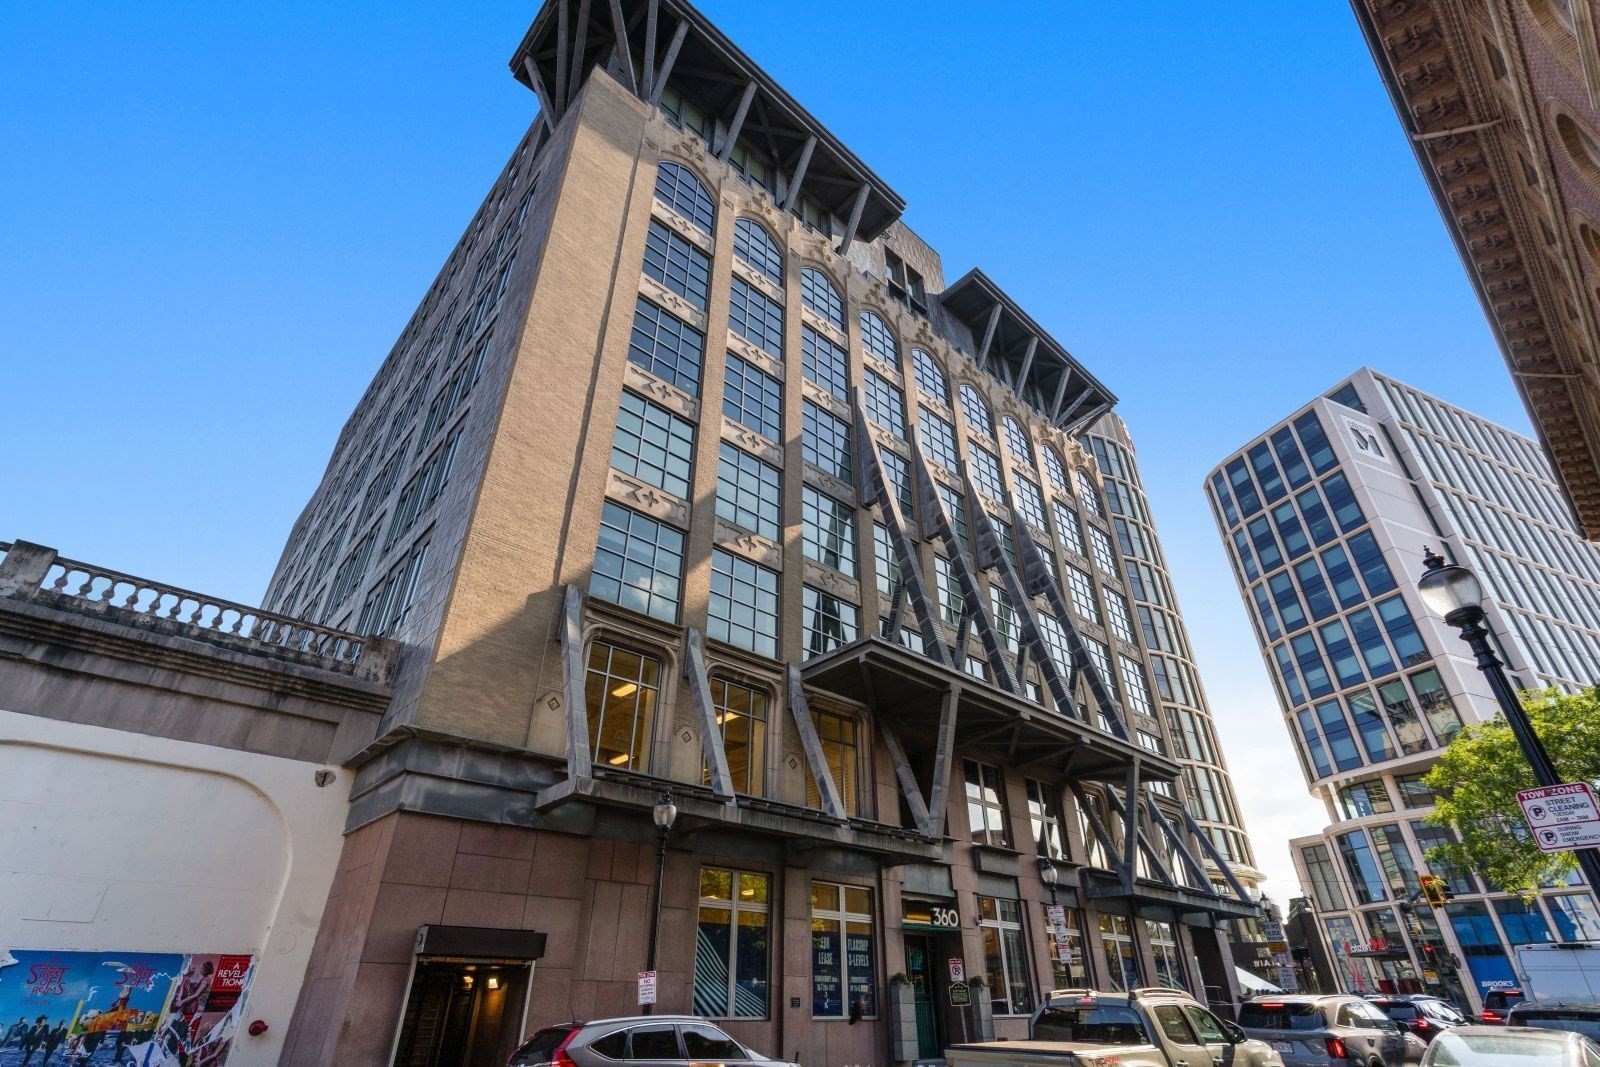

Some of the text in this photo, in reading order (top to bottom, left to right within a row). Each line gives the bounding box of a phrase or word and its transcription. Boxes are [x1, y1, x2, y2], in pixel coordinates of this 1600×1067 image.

[1521, 785, 1584, 800] TOW ZONE
[1545, 797, 1576, 806] STREET
[1547, 802, 1590, 813] CLEANING
[931, 907, 959, 927] 360
[818, 951, 833, 965] LEASE
[232, 962, 240, 970] A
[1481, 980, 1514, 988] BROOKS
